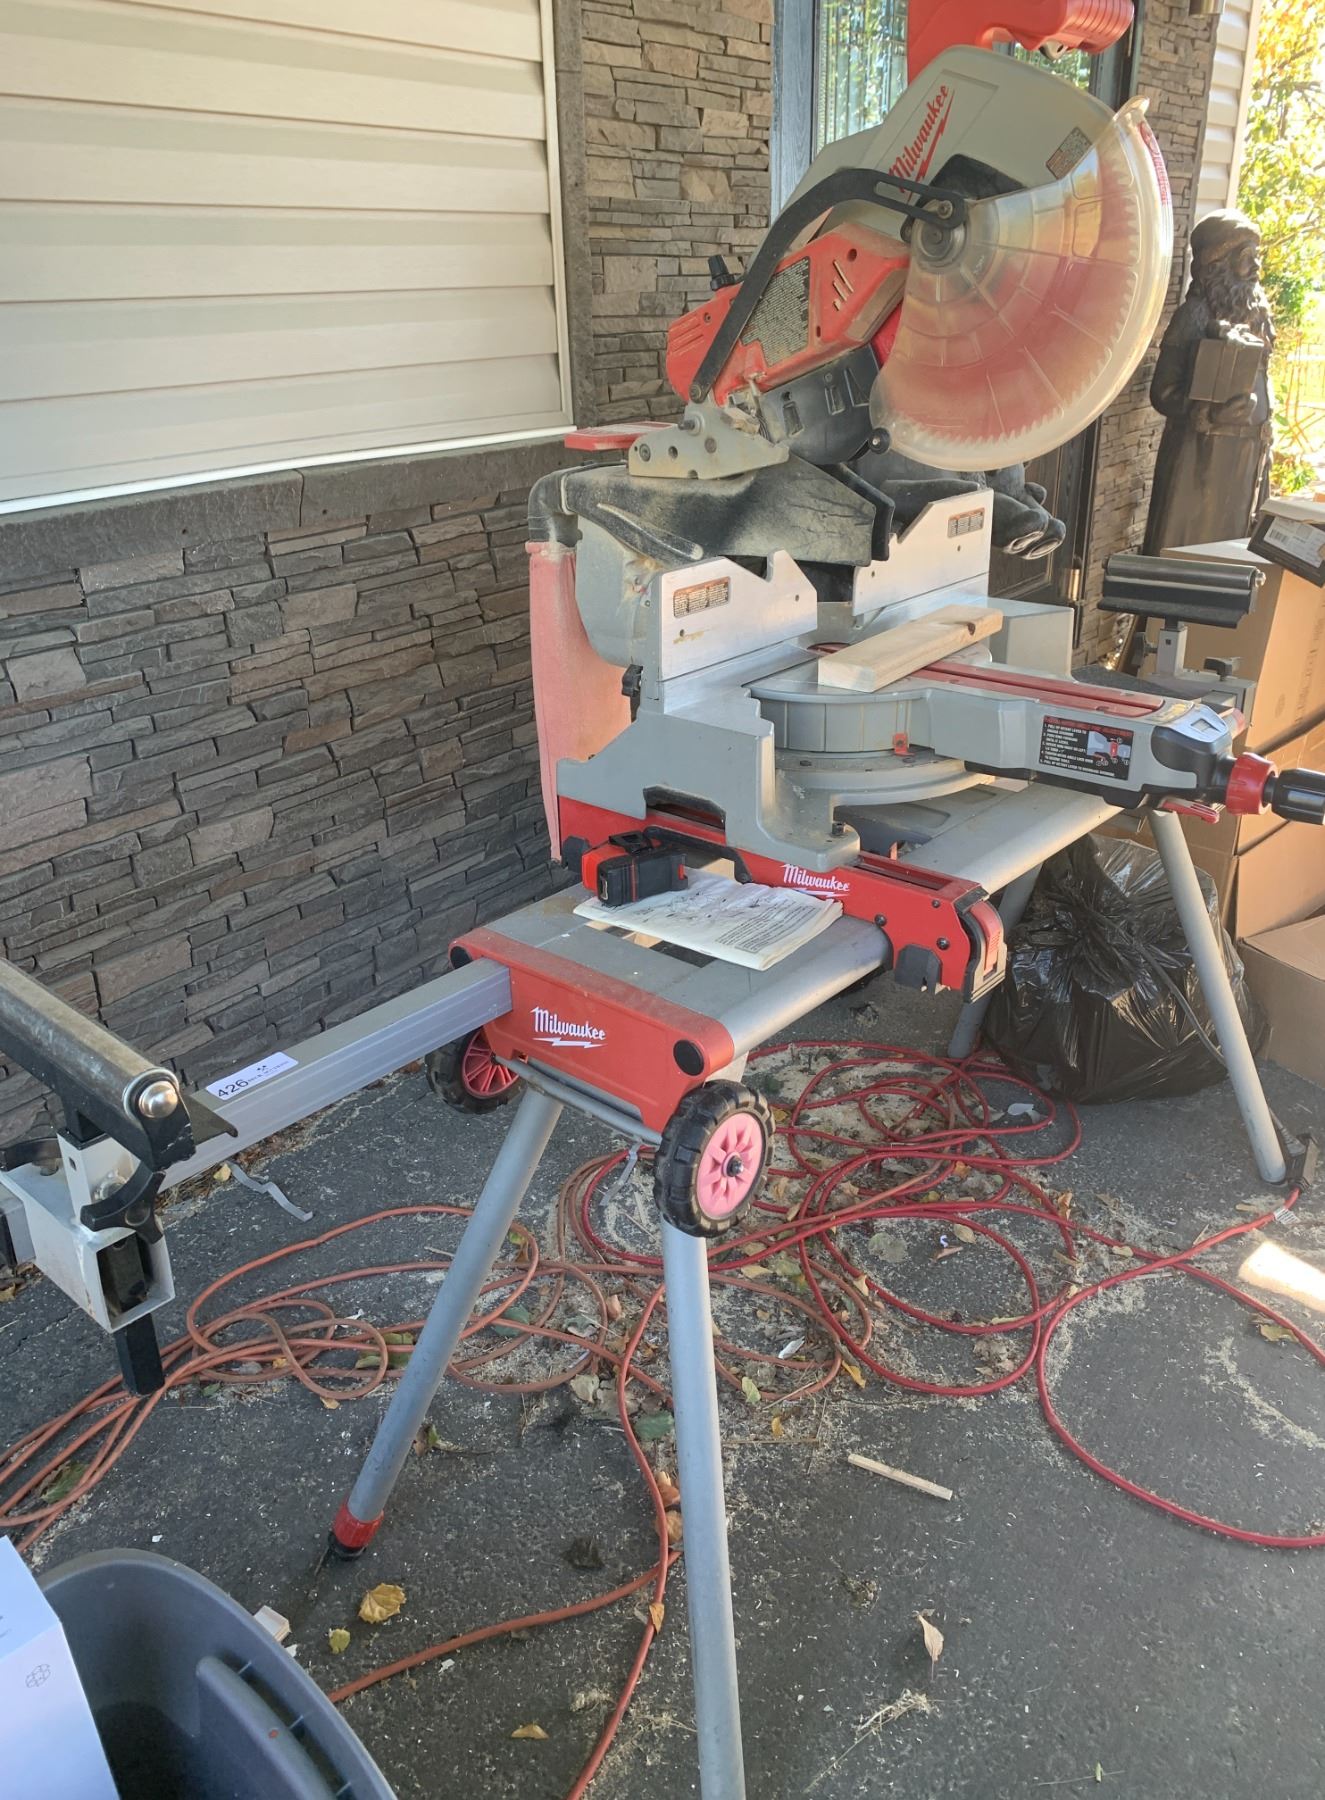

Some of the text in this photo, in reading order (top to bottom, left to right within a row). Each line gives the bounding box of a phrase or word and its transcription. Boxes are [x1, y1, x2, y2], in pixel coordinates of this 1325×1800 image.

[888, 85, 948, 193] Milwaukee
[780, 863, 850, 891] Milwaukee
[530, 1006, 606, 1040] Milwaukee
[218, 1079, 249, 1097] 426
